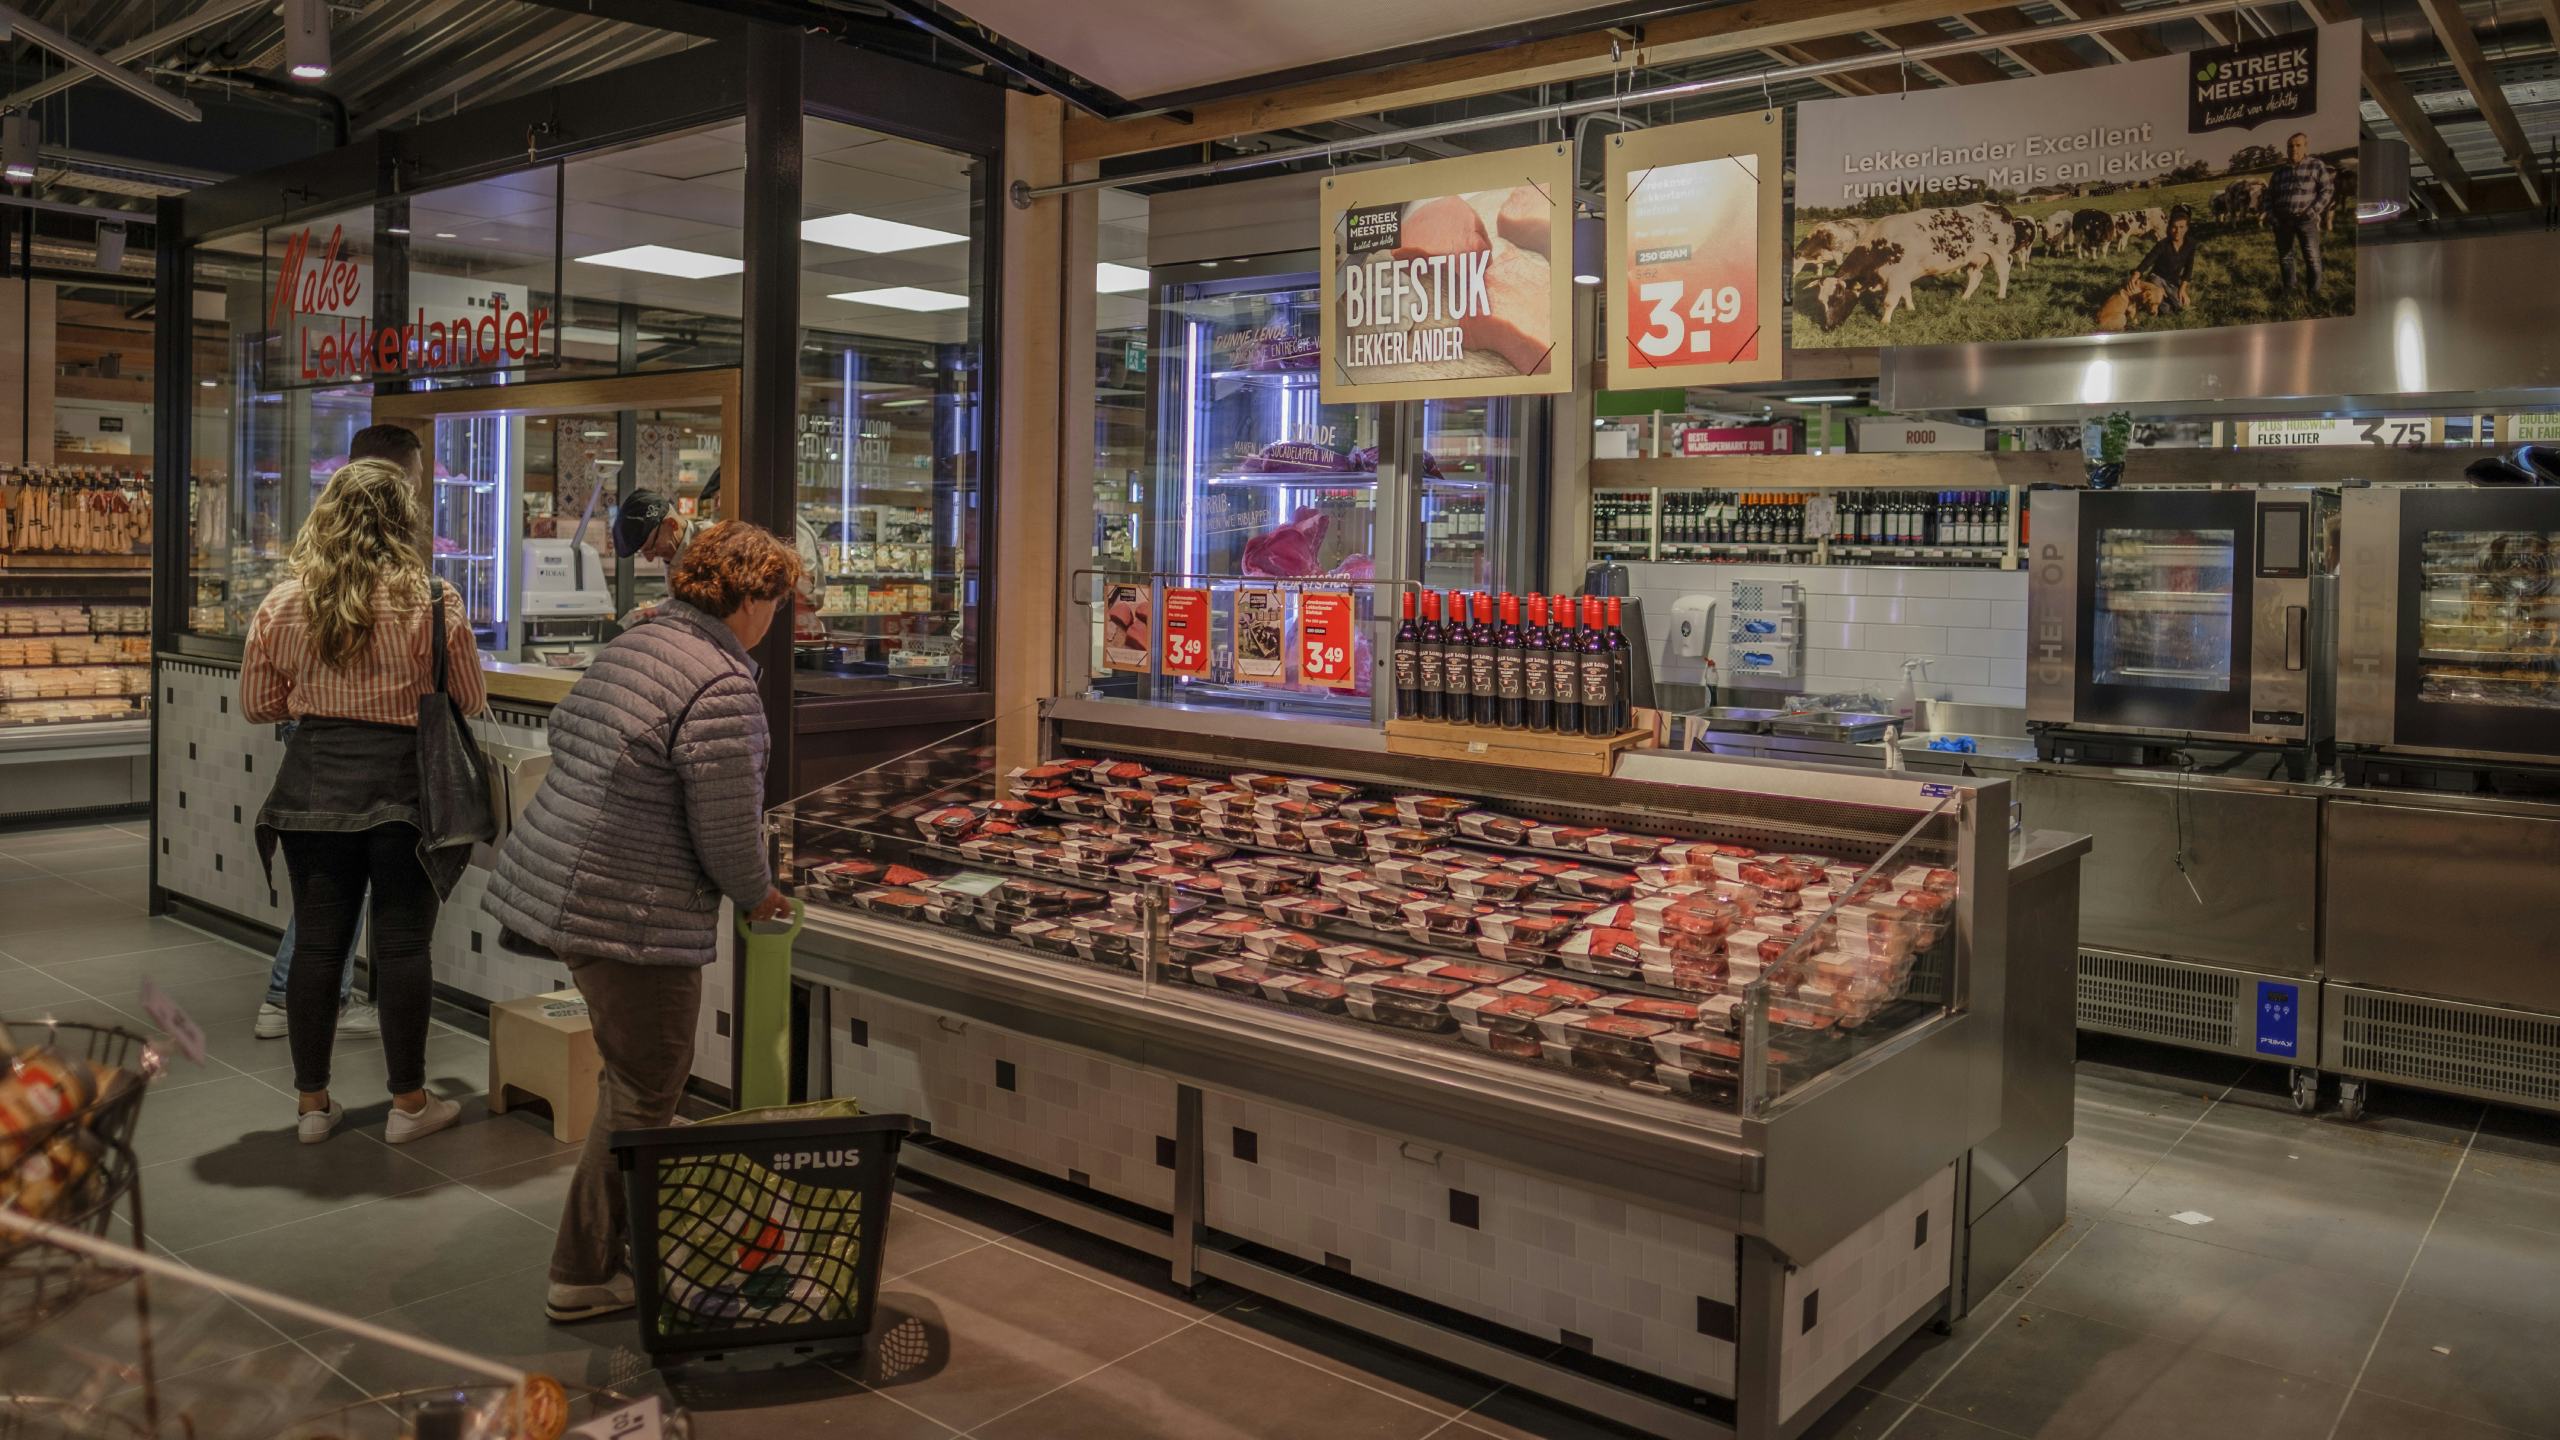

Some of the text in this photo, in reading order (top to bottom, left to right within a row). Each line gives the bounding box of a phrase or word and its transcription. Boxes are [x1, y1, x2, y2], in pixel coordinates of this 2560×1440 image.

[2219, 48, 2309, 80] STREEK
[2198, 68, 2309, 102] MEESTERS
[1843, 122, 2152, 174] Lekkerlander Excellent
[1843, 148, 2191, 200] rundvlees. Mals en lekker.
[1350, 222, 1399, 238] MEESTERS
[1359, 211, 1398, 226] STREEK
[1639, 248, 1689, 263] 250 GRAM
[269, 223, 361, 328] Malse
[1346, 250, 1491, 327] BIEFSTUK
[1637, 280, 1742, 357] 3.49
[301, 296, 550, 380] Lekkerlander
[1346, 326, 1464, 367] LEKKERLANDER
[1688, 432, 1709, 442] BESTE
[1906, 430, 1936, 444] ROOD
[2257, 418, 2283, 431] PLUS
[2519, 426, 2533, 439] EN
[2257, 432, 2320, 445] FLES 1 LITER
[2038, 543, 2064, 686] CHEFOP
[2260, 1036, 2293, 1048] PRIMAX
[794, 1149, 860, 1169] PLUS
